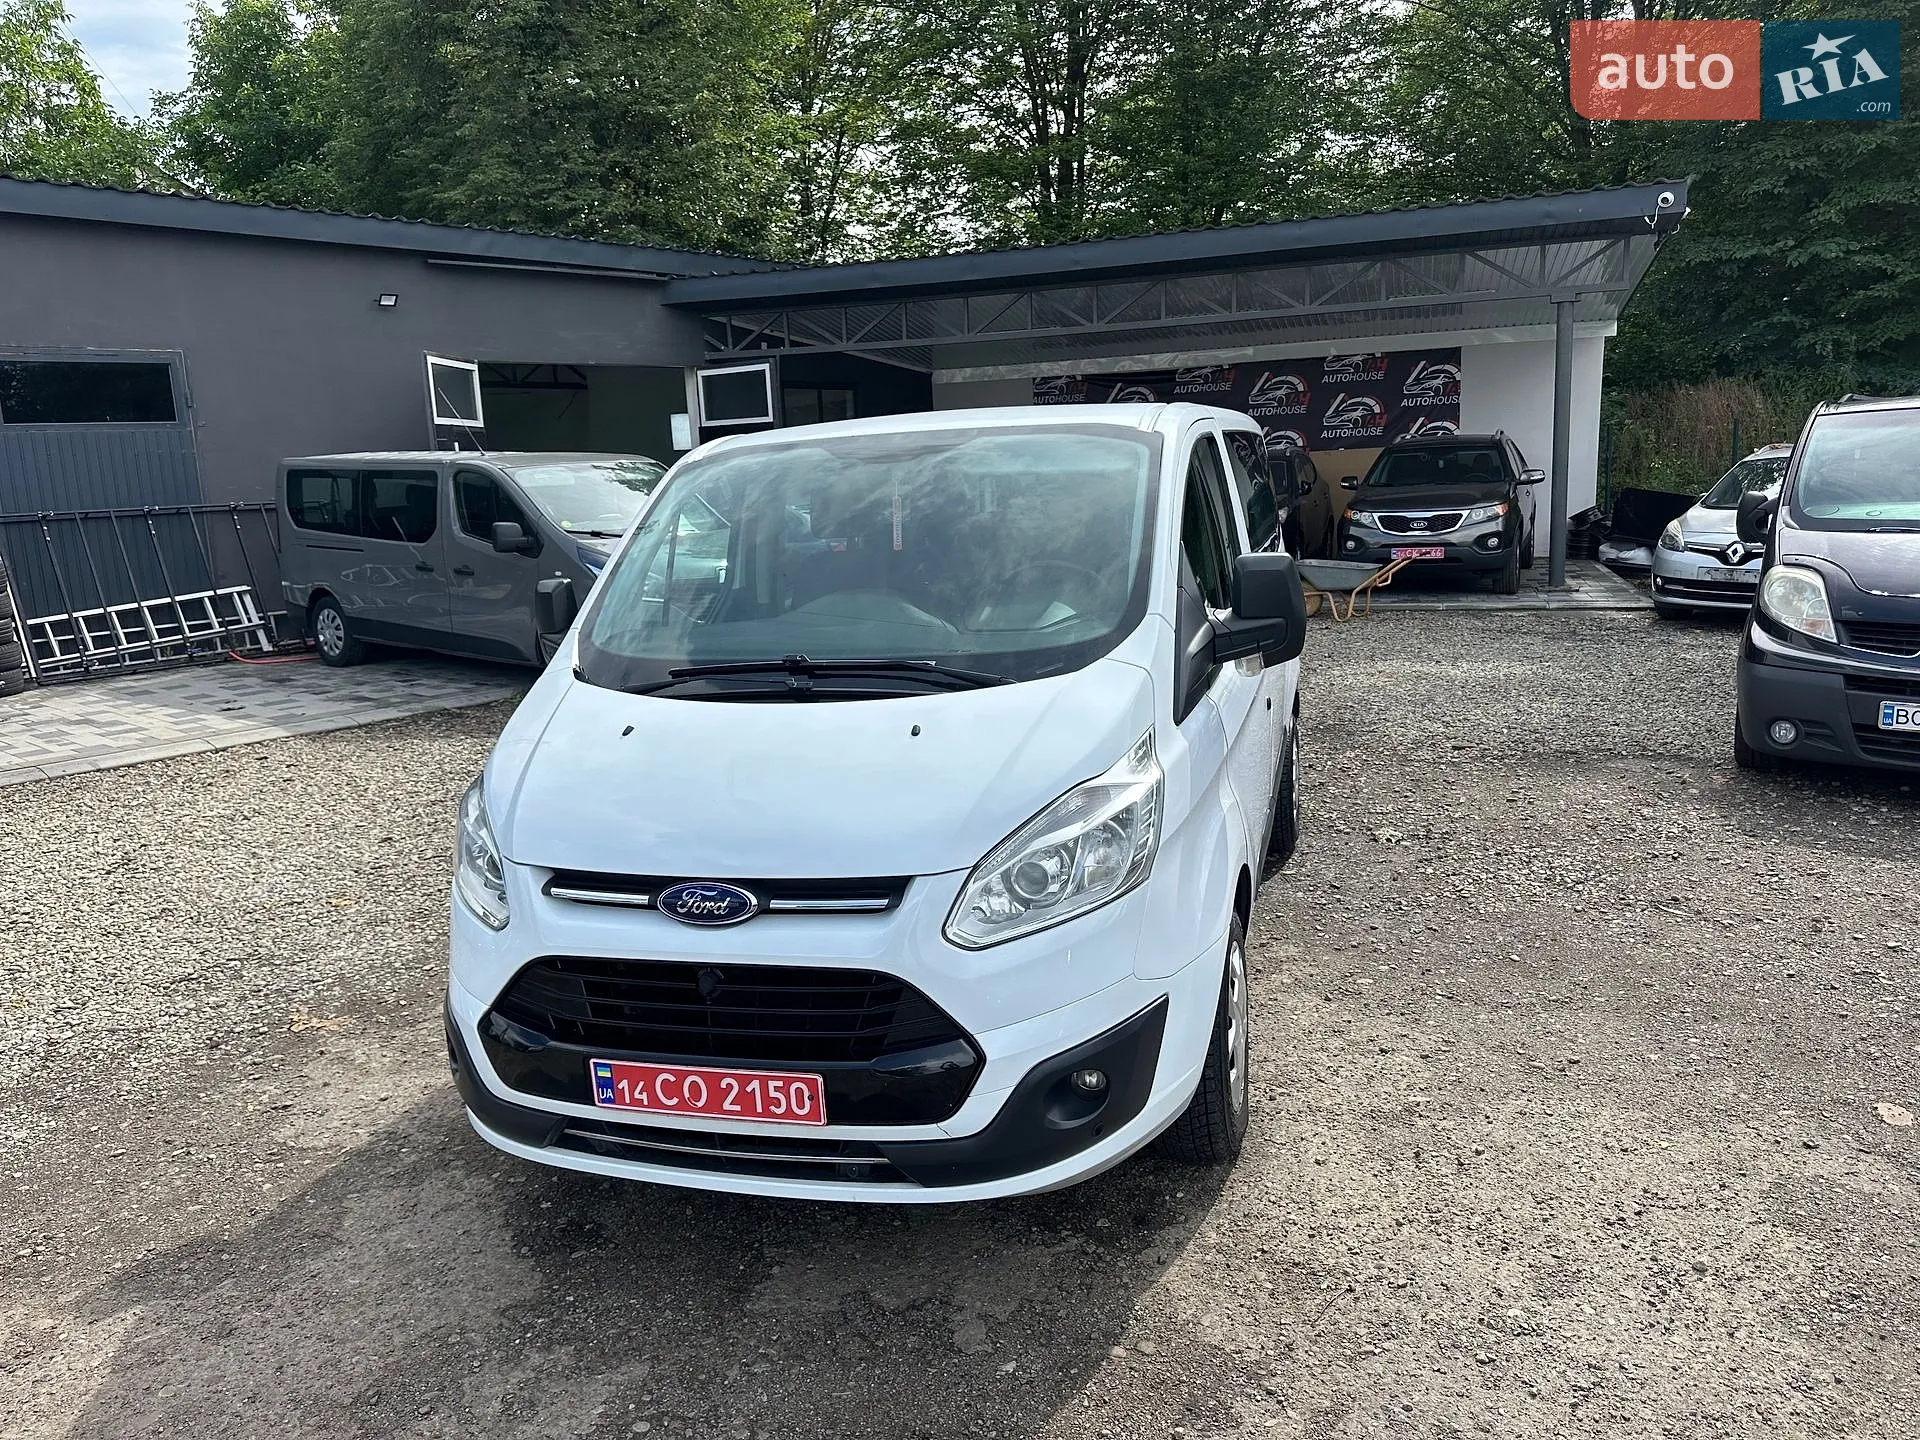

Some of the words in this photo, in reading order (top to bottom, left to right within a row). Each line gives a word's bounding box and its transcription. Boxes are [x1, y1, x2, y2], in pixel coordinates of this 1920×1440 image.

[1321, 371, 1385, 384] AUTOHOUSE
[1173, 382, 1232, 394] AUTOHOUSE
[1033, 393, 1086, 404] AUTOHOUSE
[1401, 395, 1461, 407] AUTOHOUS
[1247, 405, 1308, 417] AUTOHOUSE
[1320, 427, 1384, 439] AUTOHOUSE
[676, 888, 731, 915] Ford
[599, 1087, 614, 1100] UA
[720, 1077, 812, 1115] 2150
